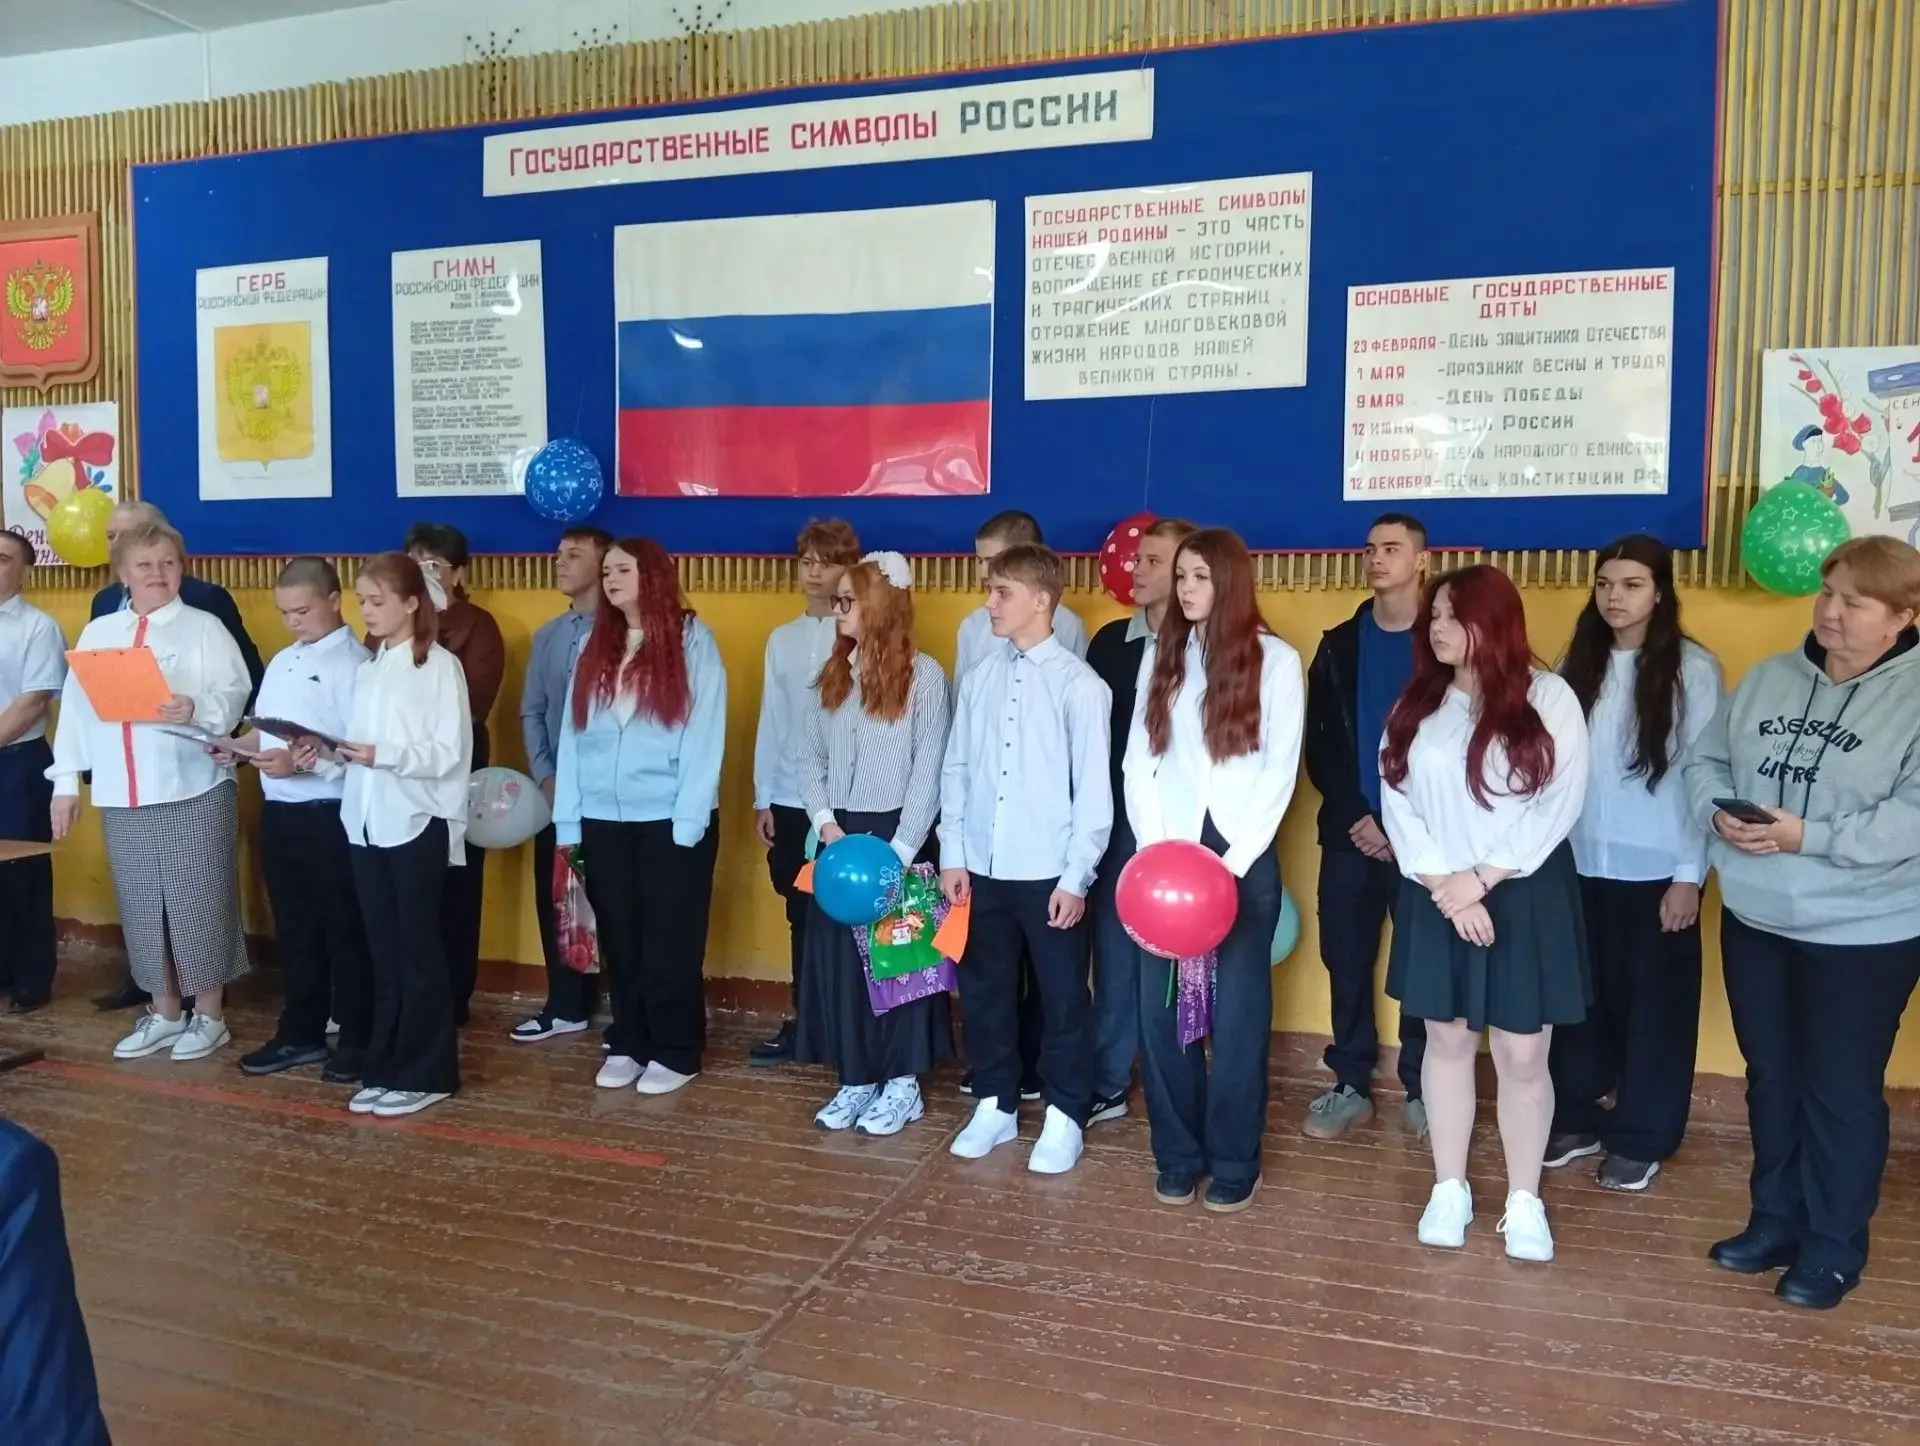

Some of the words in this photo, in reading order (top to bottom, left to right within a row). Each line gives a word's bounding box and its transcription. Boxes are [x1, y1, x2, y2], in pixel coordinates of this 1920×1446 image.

[509, 126, 770, 176] ГОСУДАРСТВЕННЫЕ
[790, 111, 937, 150] СИМВОЛЫ
[960, 89, 1117, 134] РОССИИ
[1032, 198, 1204, 226] ГОСУДАРСТВЕННЫЕ
[1219, 189, 1306, 211] СИМВОЛЫ
[1032, 230, 1088, 249] НАШЕЙ
[1098, 225, 1168, 243] РОДИНЫ
[1197, 219, 1231, 236] ЭТО
[1246, 214, 1305, 232] ЧАСТЬ
[433, 256, 495, 279] ГИМН
[1032, 246, 1175, 272] ОТЕЧЕСВЕННОЙ
[236, 272, 286, 293] ГЕРБ
[469, 274, 540, 290] ФЕДЕРЦИИ
[1152, 270, 1168, 287] ЕЁ
[1176, 262, 1302, 282] ГЕРОИЧЕСКИХ
[1355, 286, 1449, 307] ОСНОВНЫЕ
[1472, 274, 1668, 300] ГОСУДАРСТВЕННЫЕ
[1031, 303, 1041, 318] И
[1479, 300, 1537, 319] ДАТЫ
[1031, 321, 1130, 341] ОТРАЖЕНИЕ
[1145, 310, 1287, 334] МНОГОВЕКОВОЙ
[1031, 347, 1086, 365] ЖИЗНИ
[1099, 342, 1180, 361] НАРОДОВ
[1194, 336, 1254, 356] НАШЕЙ
[1353, 340, 1367, 353] 23
[1371, 336, 1436, 352] ФЕВРАЛЯ
[1496, 328, 1579, 346] ЗАЩИТНИКА
[1586, 325, 1667, 342] ОТЕЧЕСТВА
[1079, 366, 1155, 385] ВЕЛИКОЙ
[1356, 367, 1363, 380] 1
[1370, 366, 1405, 380] МАЯ
[1533, 358, 1587, 373] ВЕСНЫ
[1594, 357, 1603, 370] И
[1611, 354, 1666, 370] ТРУДА
[1356, 394, 1366, 409] 9
[1370, 393, 1404, 409] МАЯ
[1352, 422, 1365, 436] 12
[1494, 443, 1578, 458] НАРОДНОГО
[1351, 477, 1362, 490] 12
[1368, 475, 1432, 489] ДЕКАБРЯ
[1634, 468, 1661, 484] РФ
[899, 983, 946, 1004] FLORA
